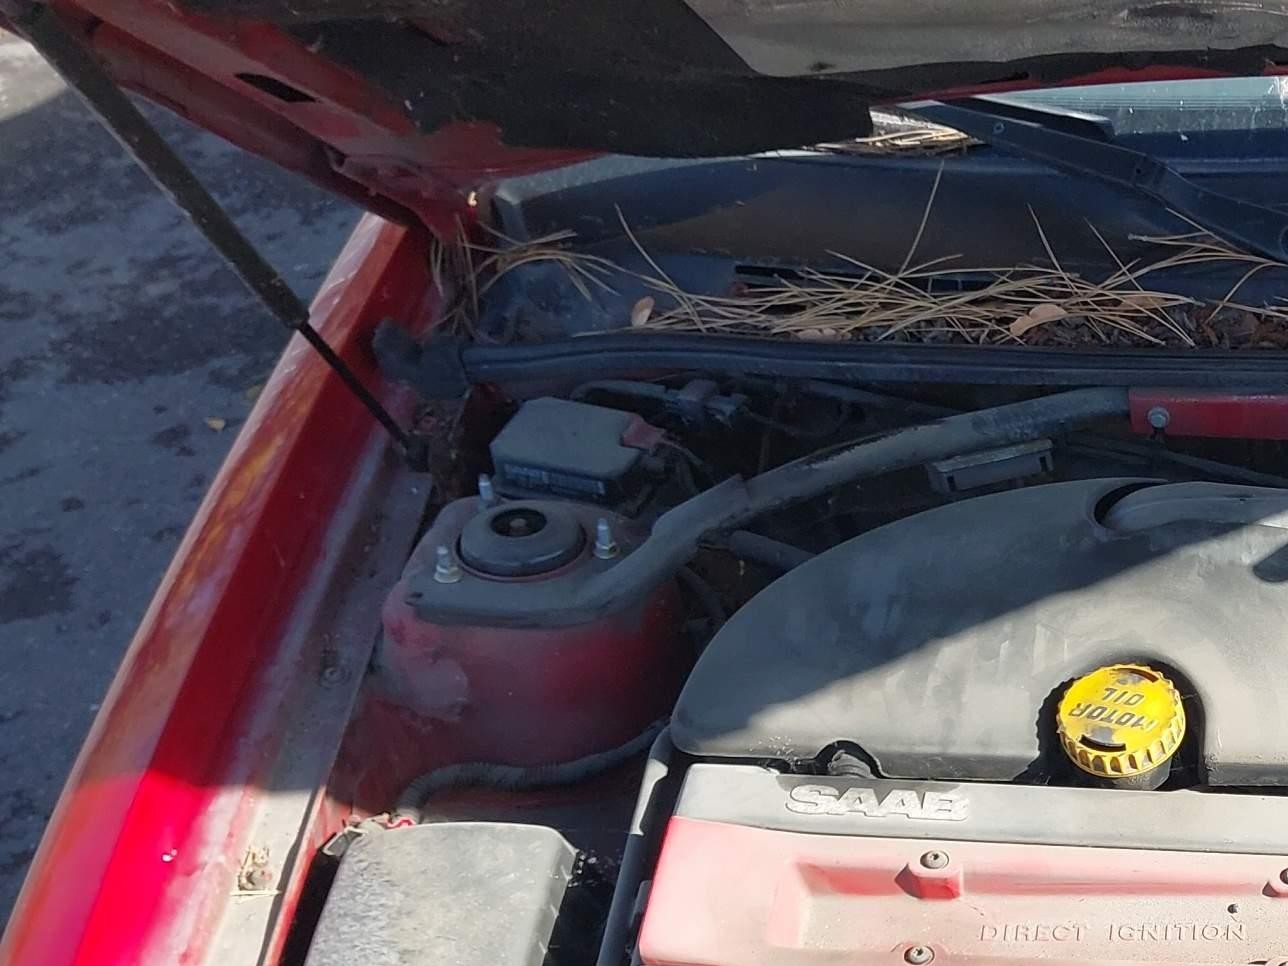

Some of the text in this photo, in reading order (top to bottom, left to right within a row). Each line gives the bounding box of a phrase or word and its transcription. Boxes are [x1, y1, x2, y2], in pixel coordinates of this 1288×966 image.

[1101, 687, 1145, 706] OIL
[1068, 703, 1158, 731] MOTOR
[785, 784, 970, 822] SAAB
[978, 922, 1246, 942] DIRECT IGNITION
